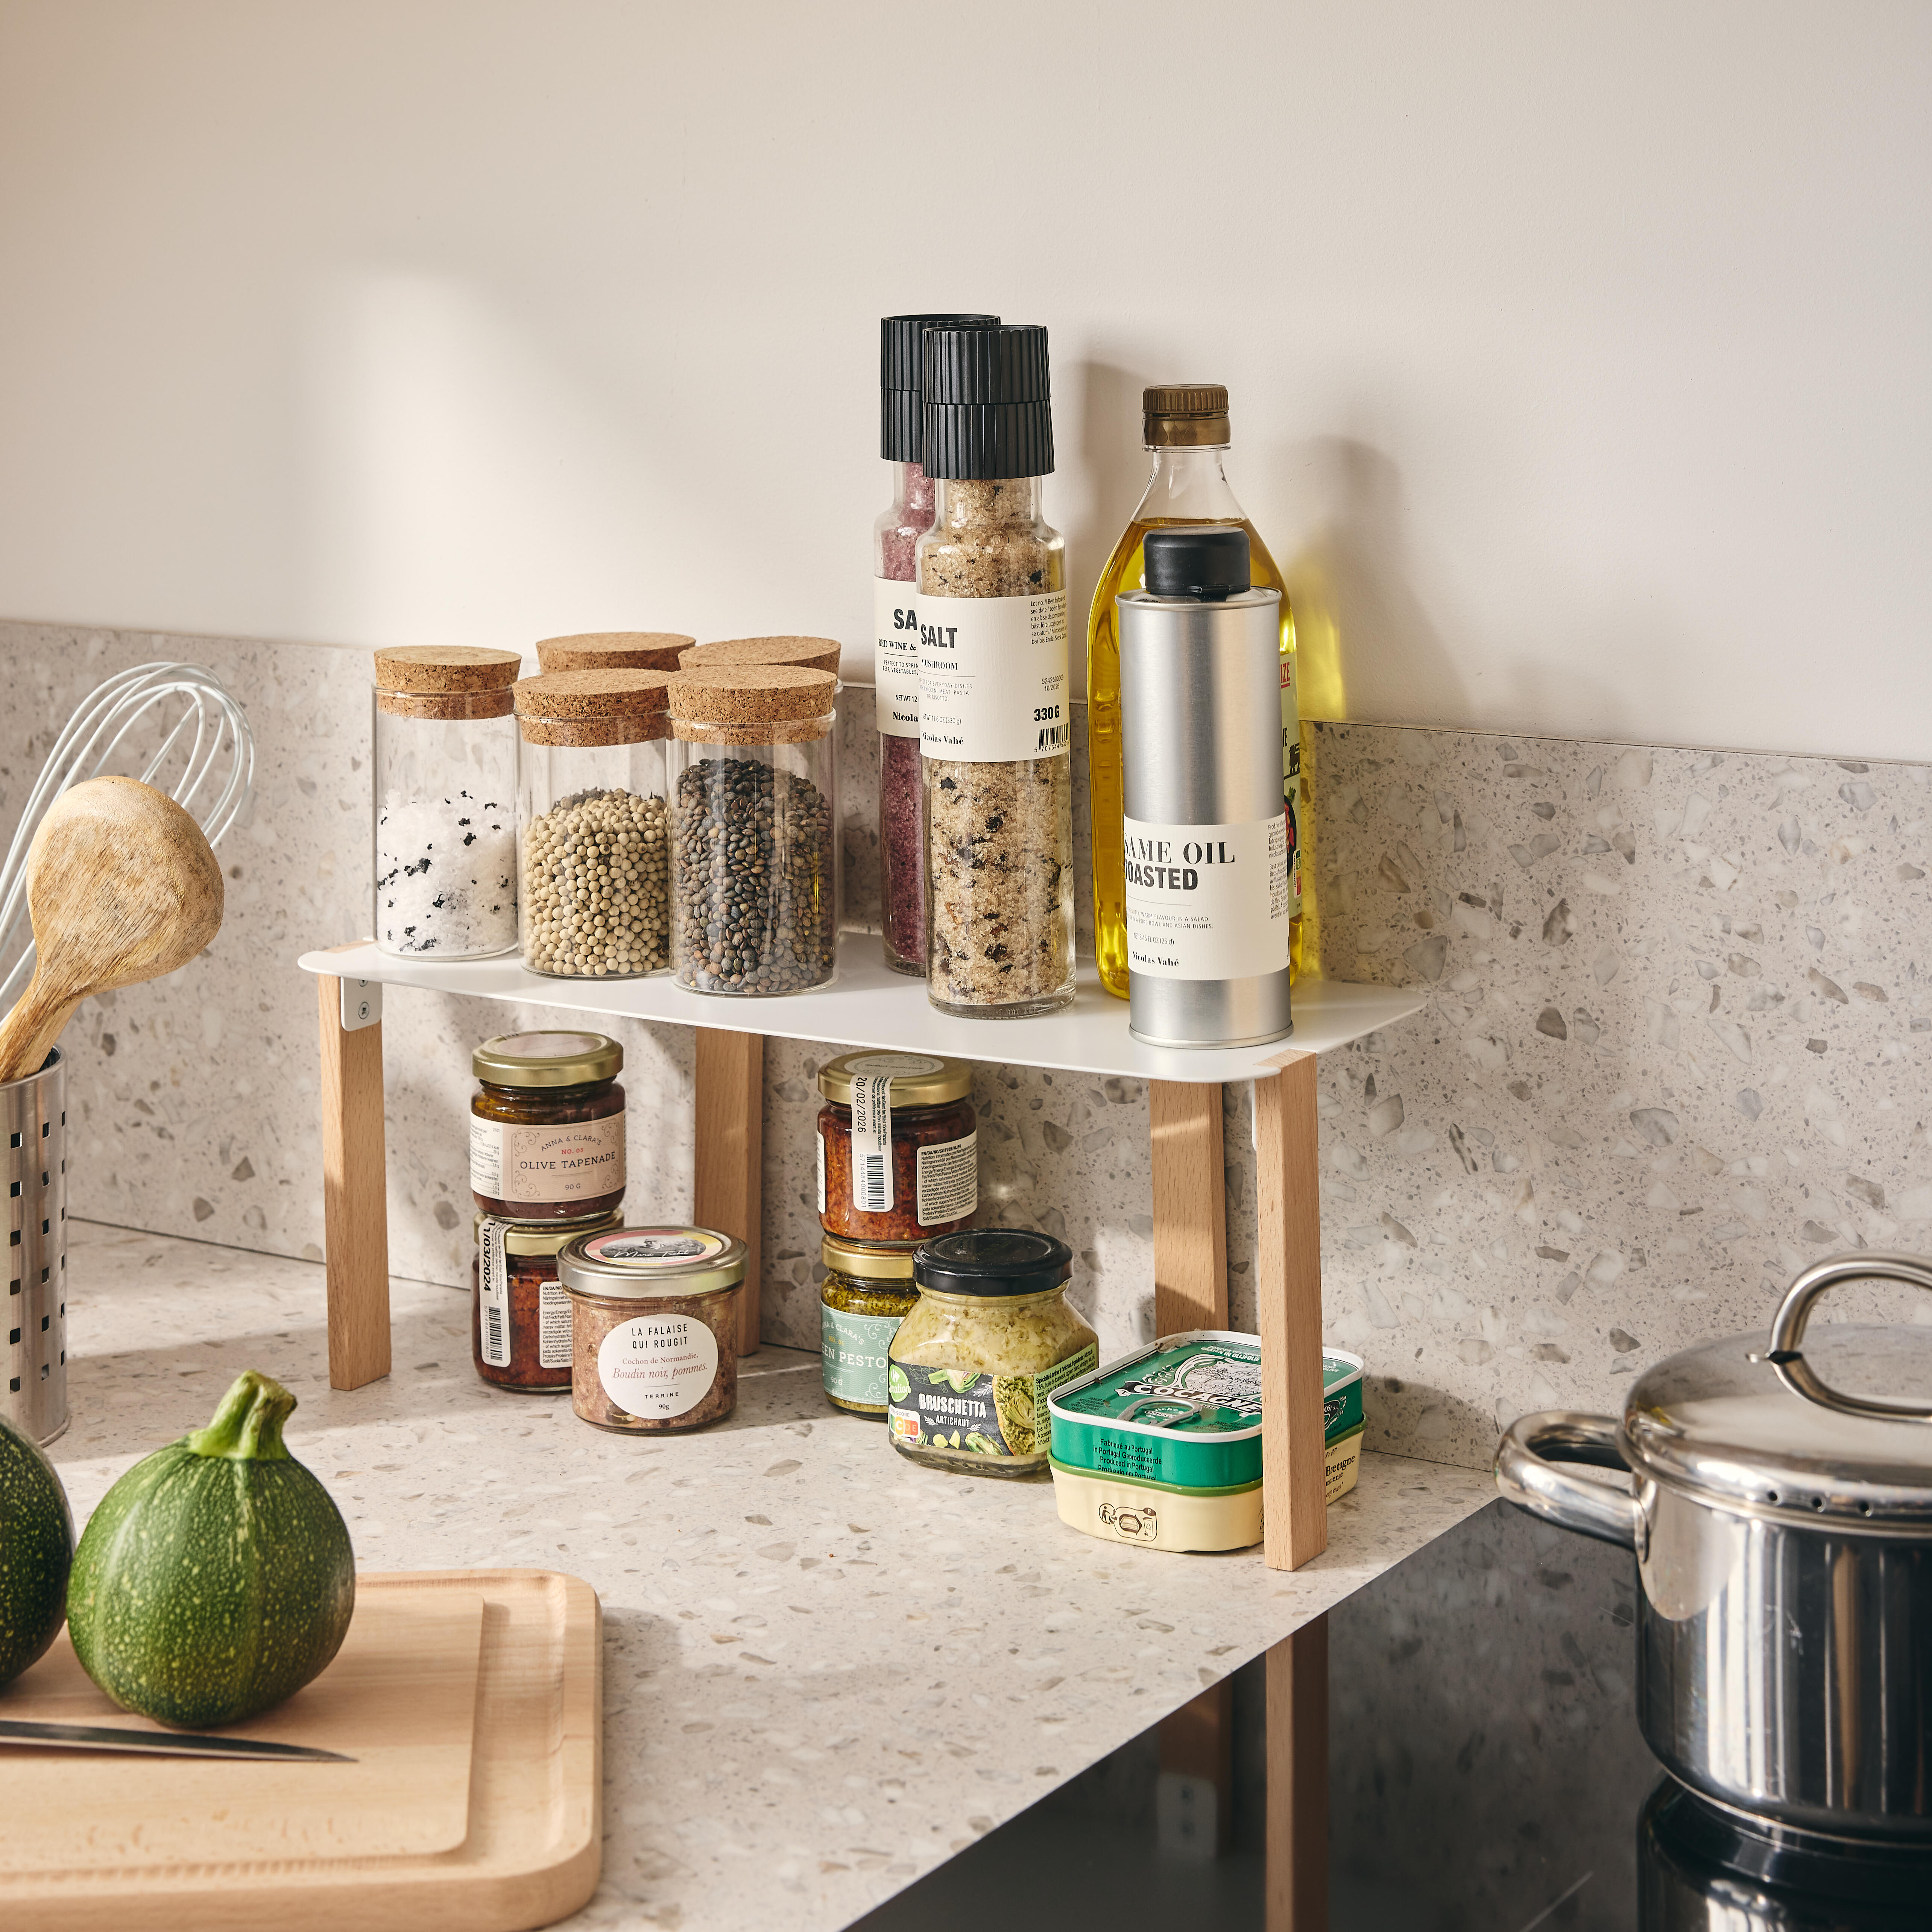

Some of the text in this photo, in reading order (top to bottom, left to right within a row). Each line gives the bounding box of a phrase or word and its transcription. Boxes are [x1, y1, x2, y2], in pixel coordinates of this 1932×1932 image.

[878, 638, 888, 647] RED
[889, 641, 908, 650] WINE
[921, 624, 957, 648] SALT
[922, 658, 957, 670] MUSHROOM
[1044, 683, 1060, 691] 10/2026
[893, 711, 920, 722] Nicola
[922, 731, 964, 745] Nicolas Vahé
[1183, 841, 1235, 864] OIL
[1132, 951, 1179, 967] Nicolas Vahé
[856, 1077, 867, 1132] 20/02/2026
[541, 1138, 563, 1151] ANNA
[574, 1135, 602, 1146] CLARA'S
[561, 1151, 615, 1168] TAPENADE
[632, 1323, 687, 1336] LA FALAISE
[836, 1324, 864, 1345] CLARA'S
[632, 1336, 688, 1349] QUI ROUGIT
[660, 1353, 698, 1363] Normandie,
[839, 1351, 887, 1368] PESTO
[612, 1363, 707, 1379] Boudin noir, pommes.
[1036, 1374, 1050, 1384] Spécialité
[919, 1393, 987, 1418] BRUSCHETTA
[1134, 1385, 1261, 1413] COCAGNE
[895, 1419, 902, 1431] C
[936, 1415, 970, 1428] ARTICHAUT
[1100, 1438, 1123, 1449] Fabriqué
[1132, 1445, 1153, 1455] Portugal
[1099, 1447, 1120, 1458] Portugal
[1122, 1452, 1162, 1464] Geproduceerde
[1098, 1464, 1124, 1475] Produzido
[1100, 1456, 1125, 1467] Produced
[1132, 1463, 1154, 1473] Portugal
[1325, 1455, 1355, 1477] Bretagne
